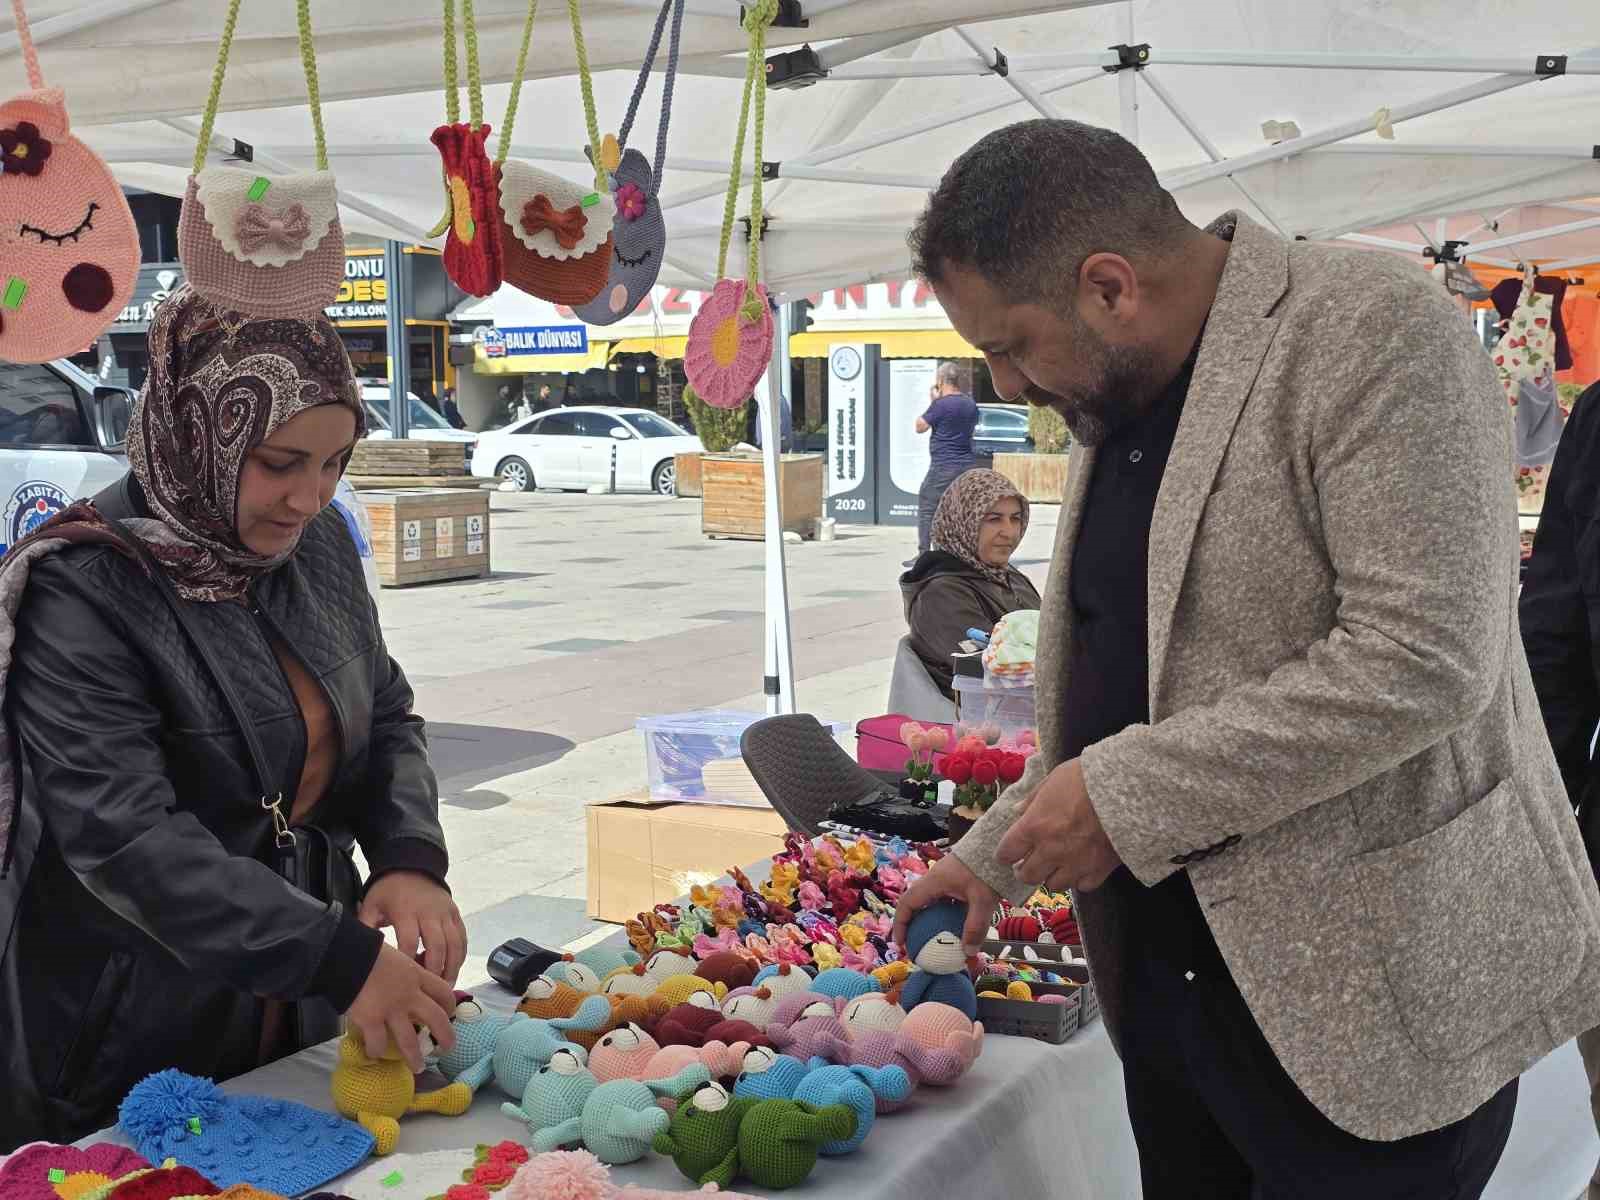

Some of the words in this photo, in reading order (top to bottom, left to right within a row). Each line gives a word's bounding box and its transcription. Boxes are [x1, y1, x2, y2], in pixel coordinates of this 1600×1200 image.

[505, 331, 536, 350] BALIK
[537, 328, 583, 350] DÜNYASI
[835, 498, 866, 511] 2020
